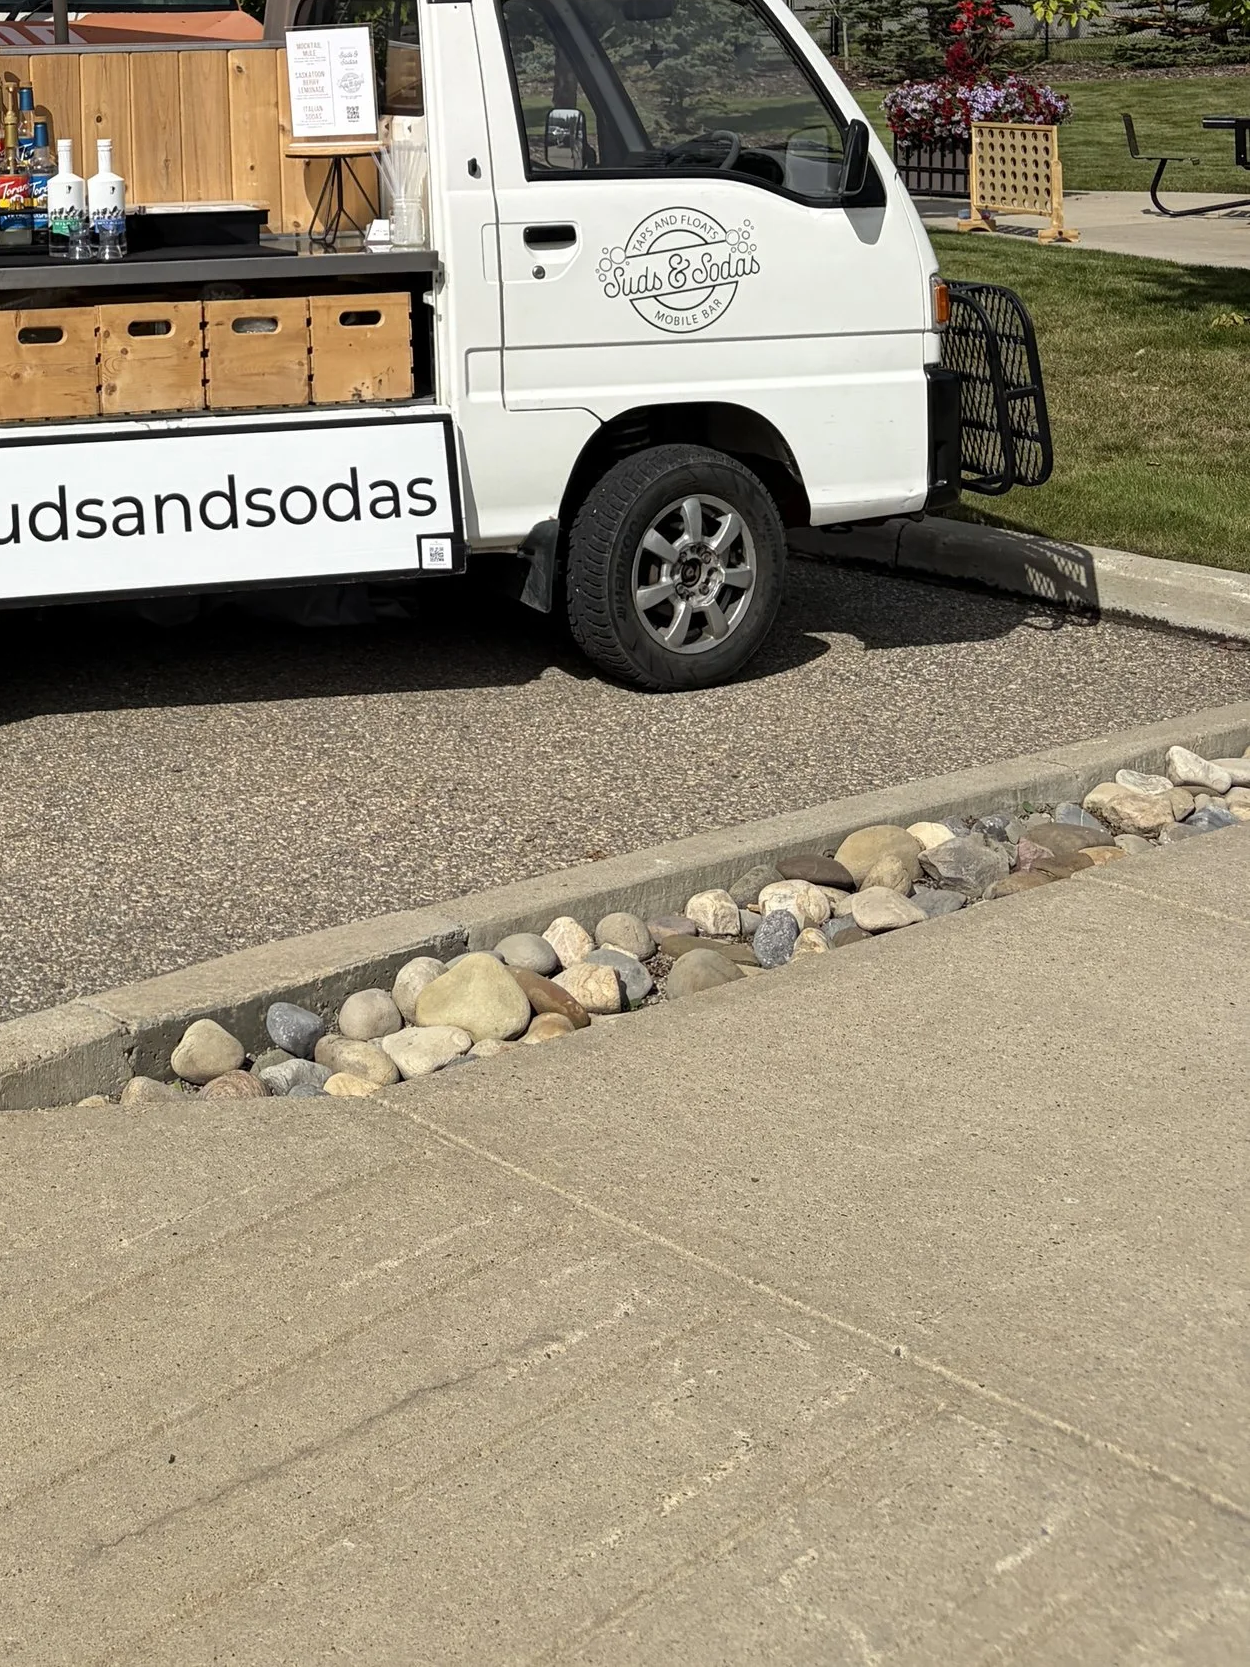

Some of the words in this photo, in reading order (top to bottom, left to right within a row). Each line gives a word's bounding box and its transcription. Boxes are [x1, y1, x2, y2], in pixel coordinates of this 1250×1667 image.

[631, 226, 654, 253] TAPS
[653, 214, 678, 232] AND
[679, 214, 720, 240] FLOATS
[603, 266, 663, 299] Suds
[668, 253, 691, 289] &
[692, 251, 761, 284] Sodas
[653, 309, 699, 327] MOBILE
[701, 297, 723, 320] BAR
